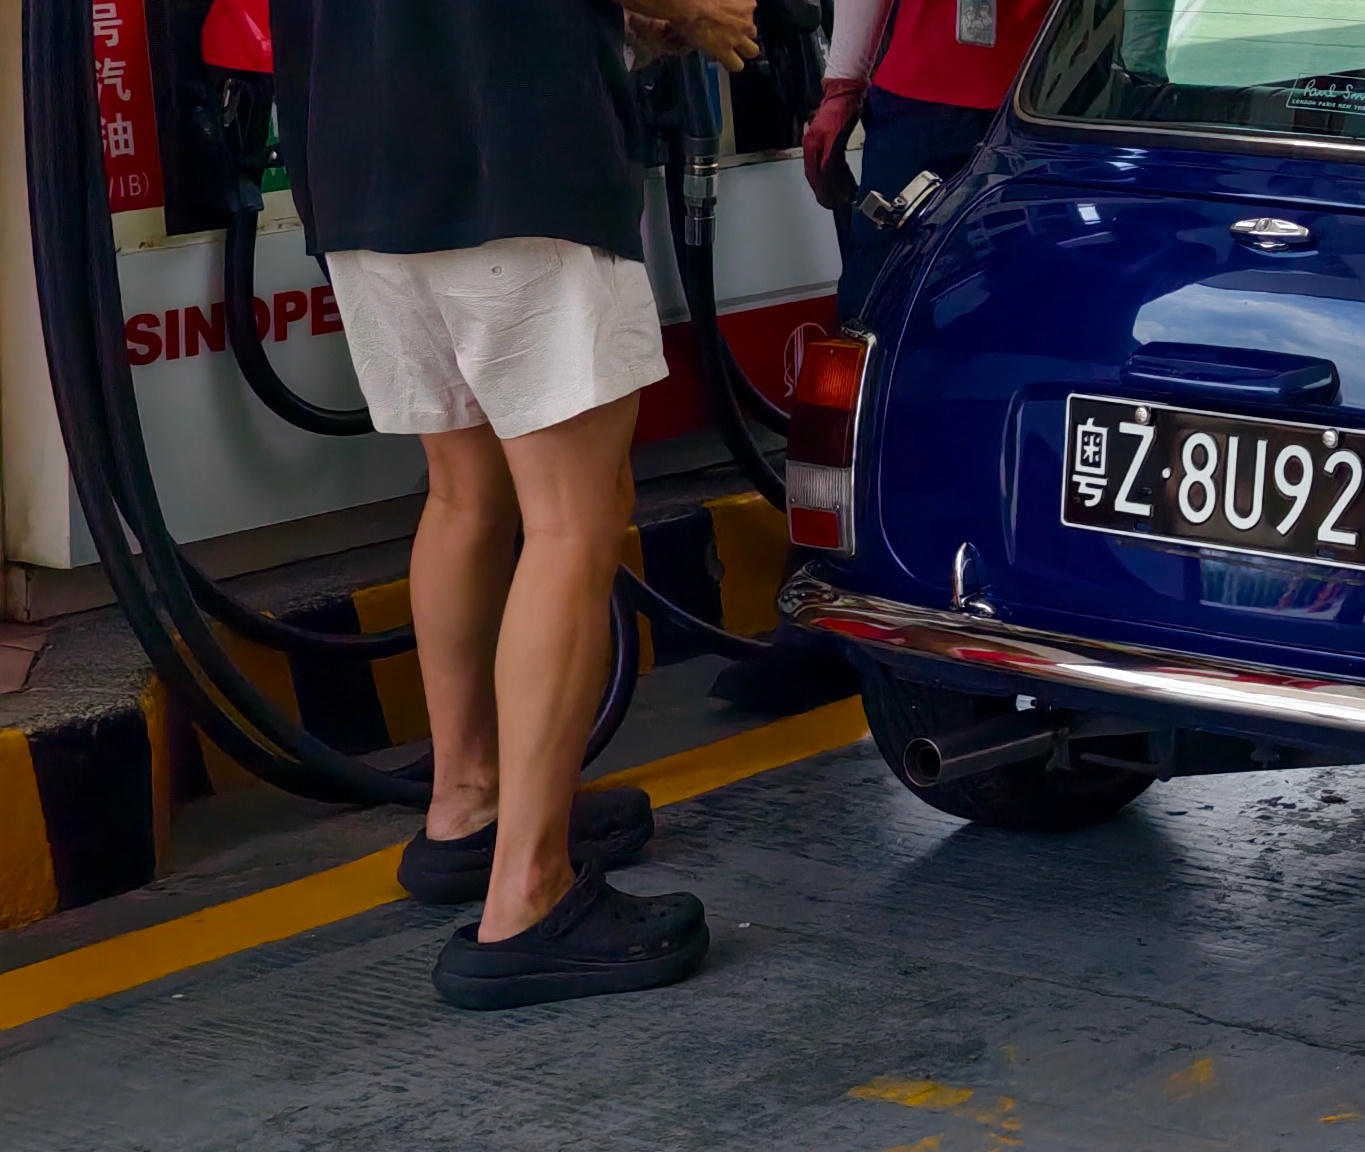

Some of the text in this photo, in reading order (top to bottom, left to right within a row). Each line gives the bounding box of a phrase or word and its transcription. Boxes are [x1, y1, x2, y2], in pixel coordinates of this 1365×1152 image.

[1303, 78, 1337, 99] Paul
[1291, 98, 1317, 107] LONDON
[1317, 100, 1336, 109] PARIS
[1338, 102, 1352, 110] NEW
